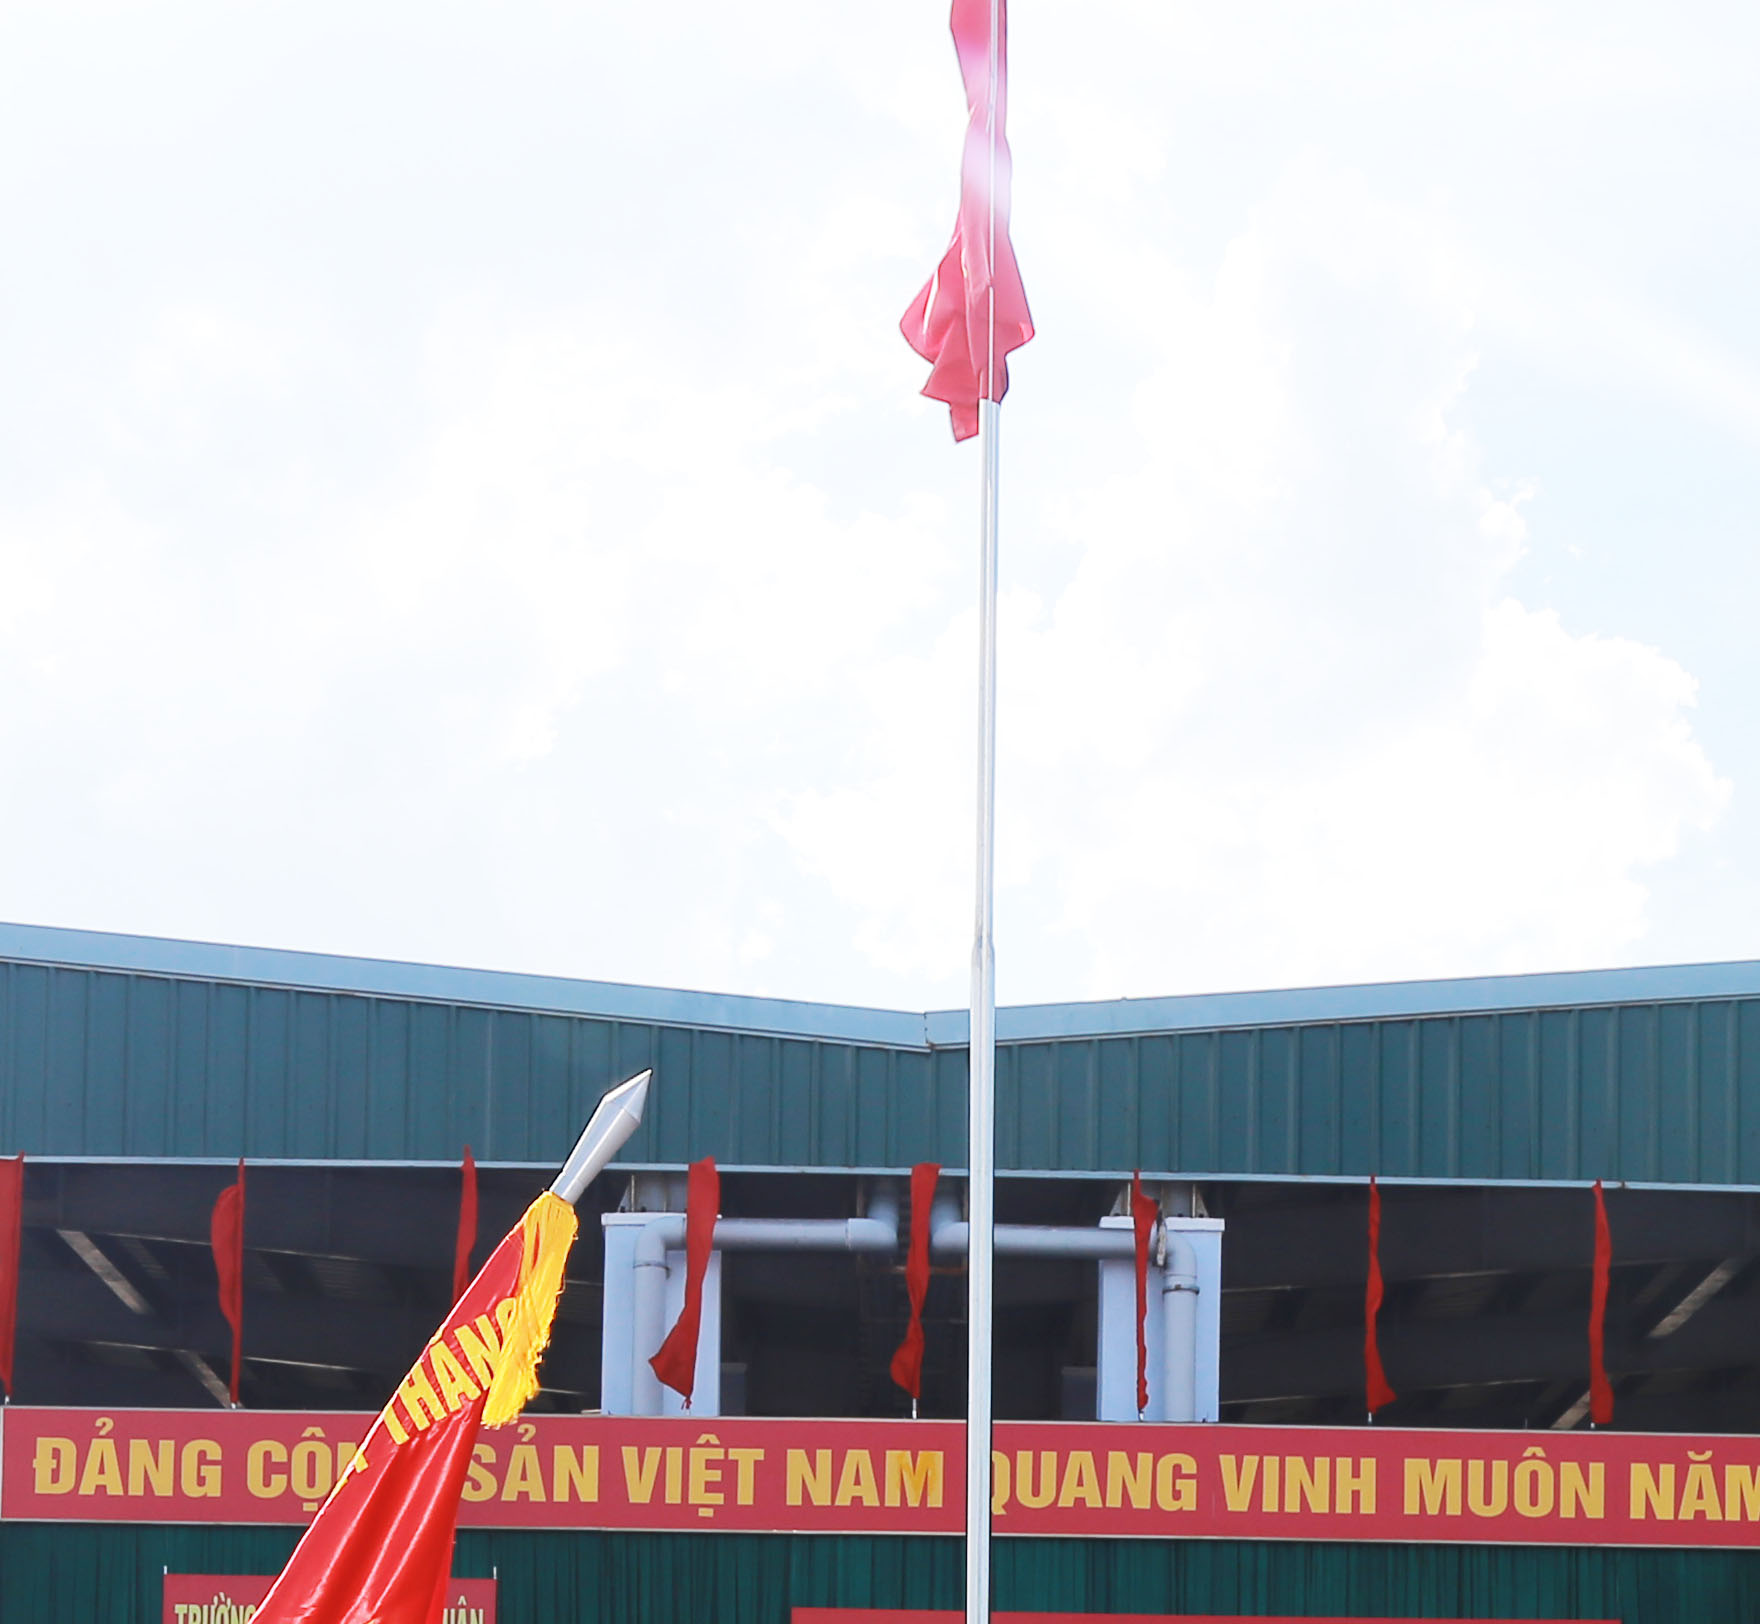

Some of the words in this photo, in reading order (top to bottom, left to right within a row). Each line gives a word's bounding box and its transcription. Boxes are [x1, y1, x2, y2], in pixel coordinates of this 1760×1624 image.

[33, 1417, 222, 1497] ĐẢNG
[247, 1427, 358, 1512] CỘ
[460, 1423, 600, 1502] SẢN
[622, 1434, 765, 1517] VIỆT
[786, 1449, 944, 1508] NAM
[1220, 1454, 1377, 1515] VINH
[1404, 1446, 1605, 1519] MUÔN
